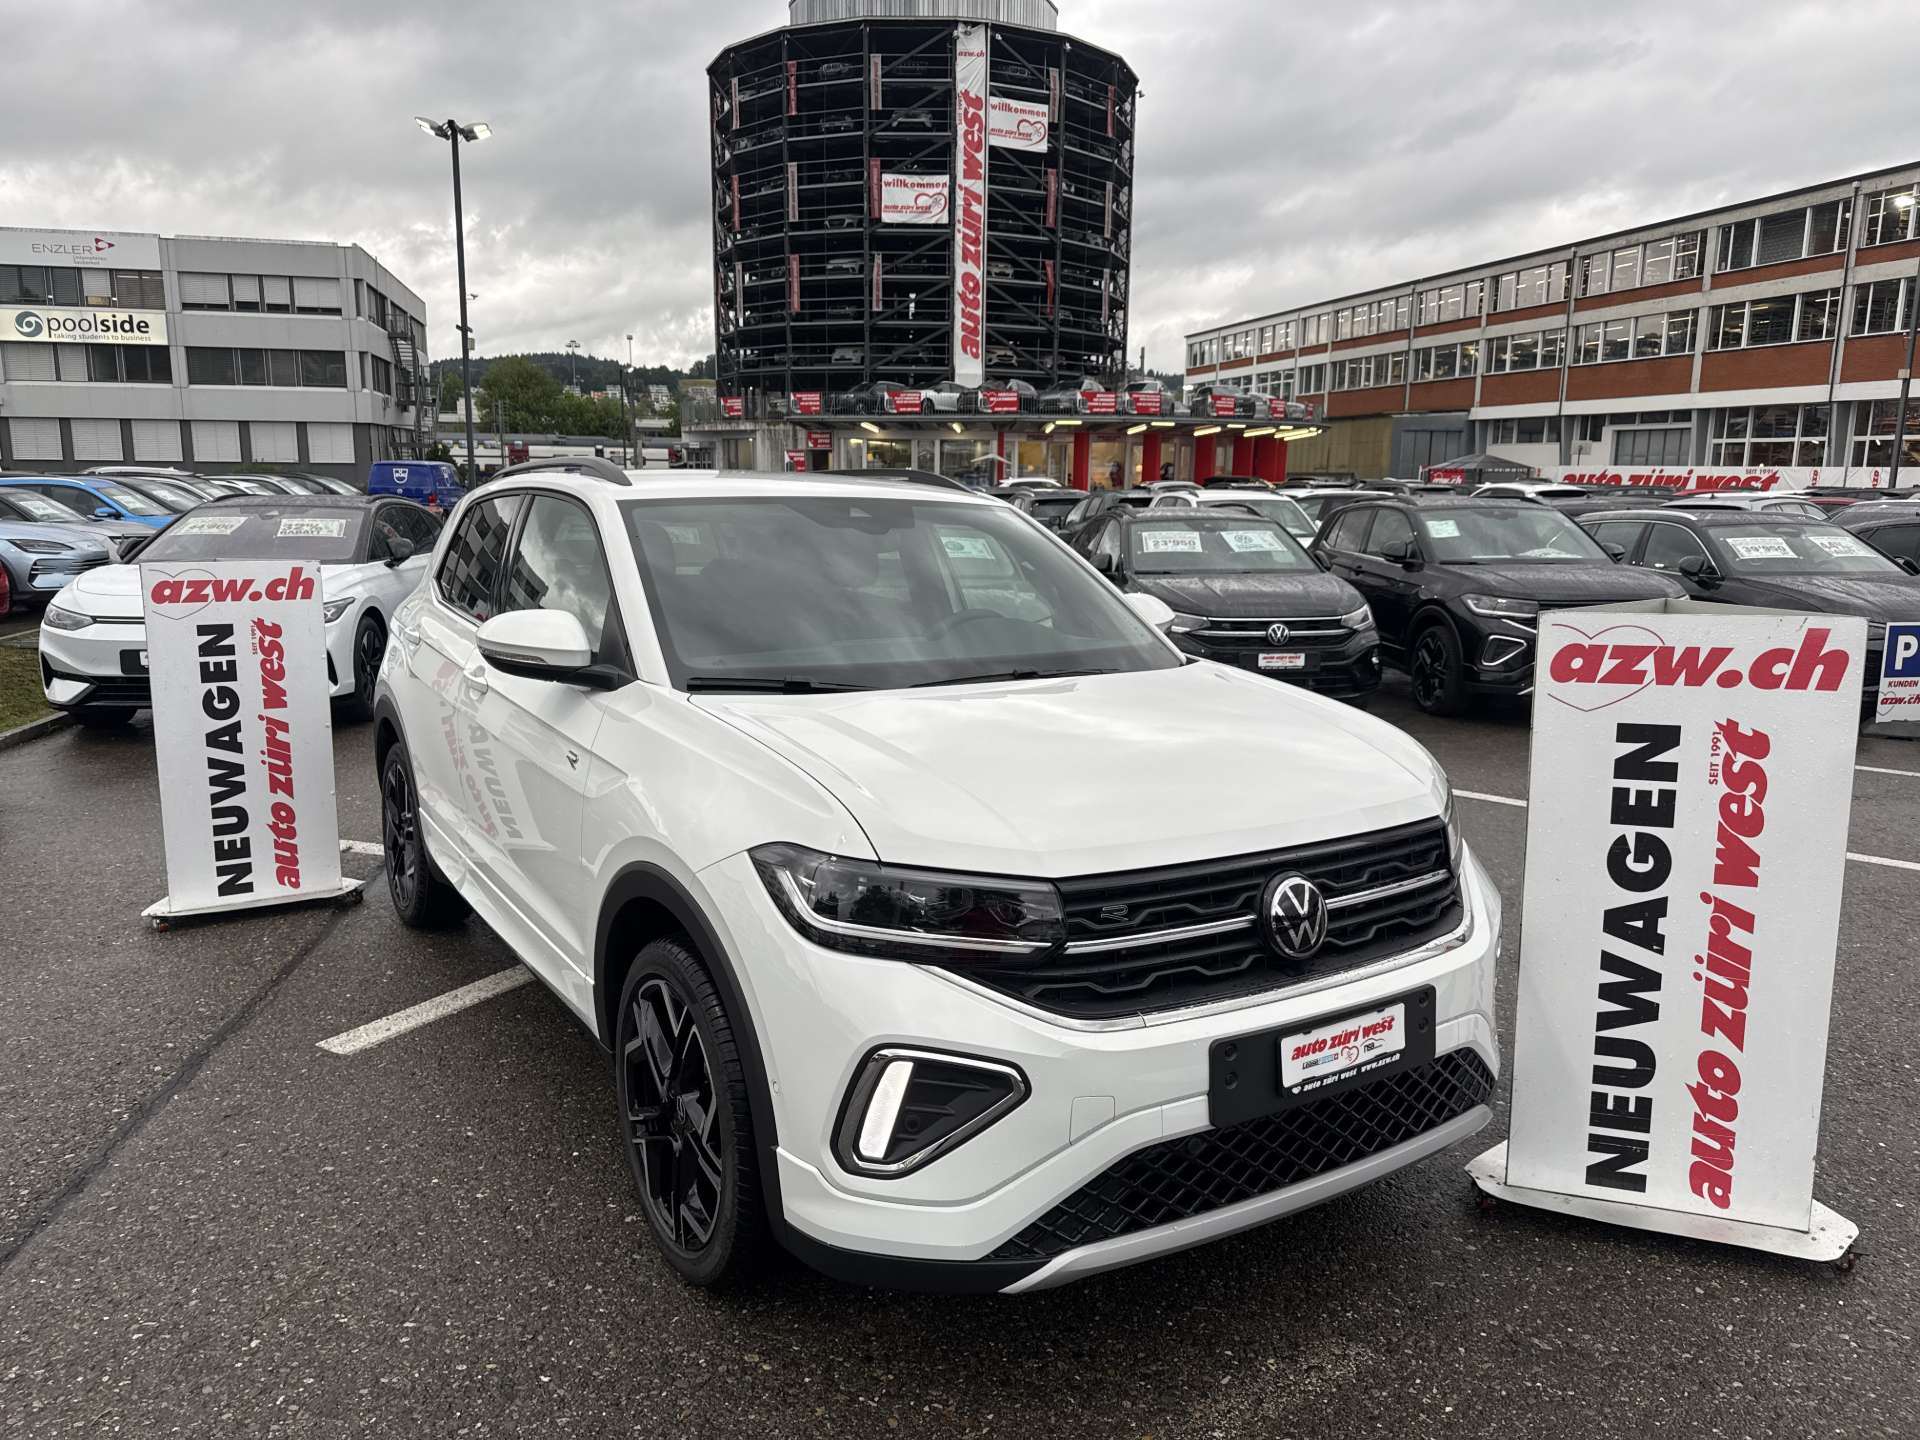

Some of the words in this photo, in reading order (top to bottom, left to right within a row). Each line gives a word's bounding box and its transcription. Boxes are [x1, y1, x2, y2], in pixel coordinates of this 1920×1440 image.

[960, 88, 985, 181] west
[990, 101, 1047, 118] willkommen
[883, 178, 948, 189] willkommen
[31, 243, 93, 255] ENZLER
[955, 183, 983, 272] züri
[47, 312, 150, 339] poolside
[54, 333, 77, 341] taking
[111, 333, 120, 341] to
[121, 333, 152, 342] business
[957, 271, 981, 360] auto
[151, 566, 315, 605] azw.ch
[252, 617, 289, 710] west
[1548, 628, 1850, 692] azw.ch
[1894, 635, 1919, 671] P
[1888, 680, 1919, 688] KUNDEN
[196, 623, 254, 897] NEUWAGEN
[257, 714, 294, 800] züri
[1709, 731, 1722, 756] 1991
[1708, 759, 1719, 786] SEIT
[1712, 718, 1772, 888] west
[266, 801, 301, 889] auto
[1585, 722, 1682, 1194] NEUWAGEN
[1691, 891, 1756, 1053] züri
[1291, 1038, 1328, 1060] auto
[1328, 1026, 1360, 1050] züri
[1362, 1015, 1396, 1039] west
[1303, 1080, 1321, 1092] auto
[1322, 1074, 1339, 1086] züri
[1340, 1068, 1358, 1080] west
[1361, 1053, 1401, 1072] www.azw.ch
[1684, 1050, 1743, 1210] auto
